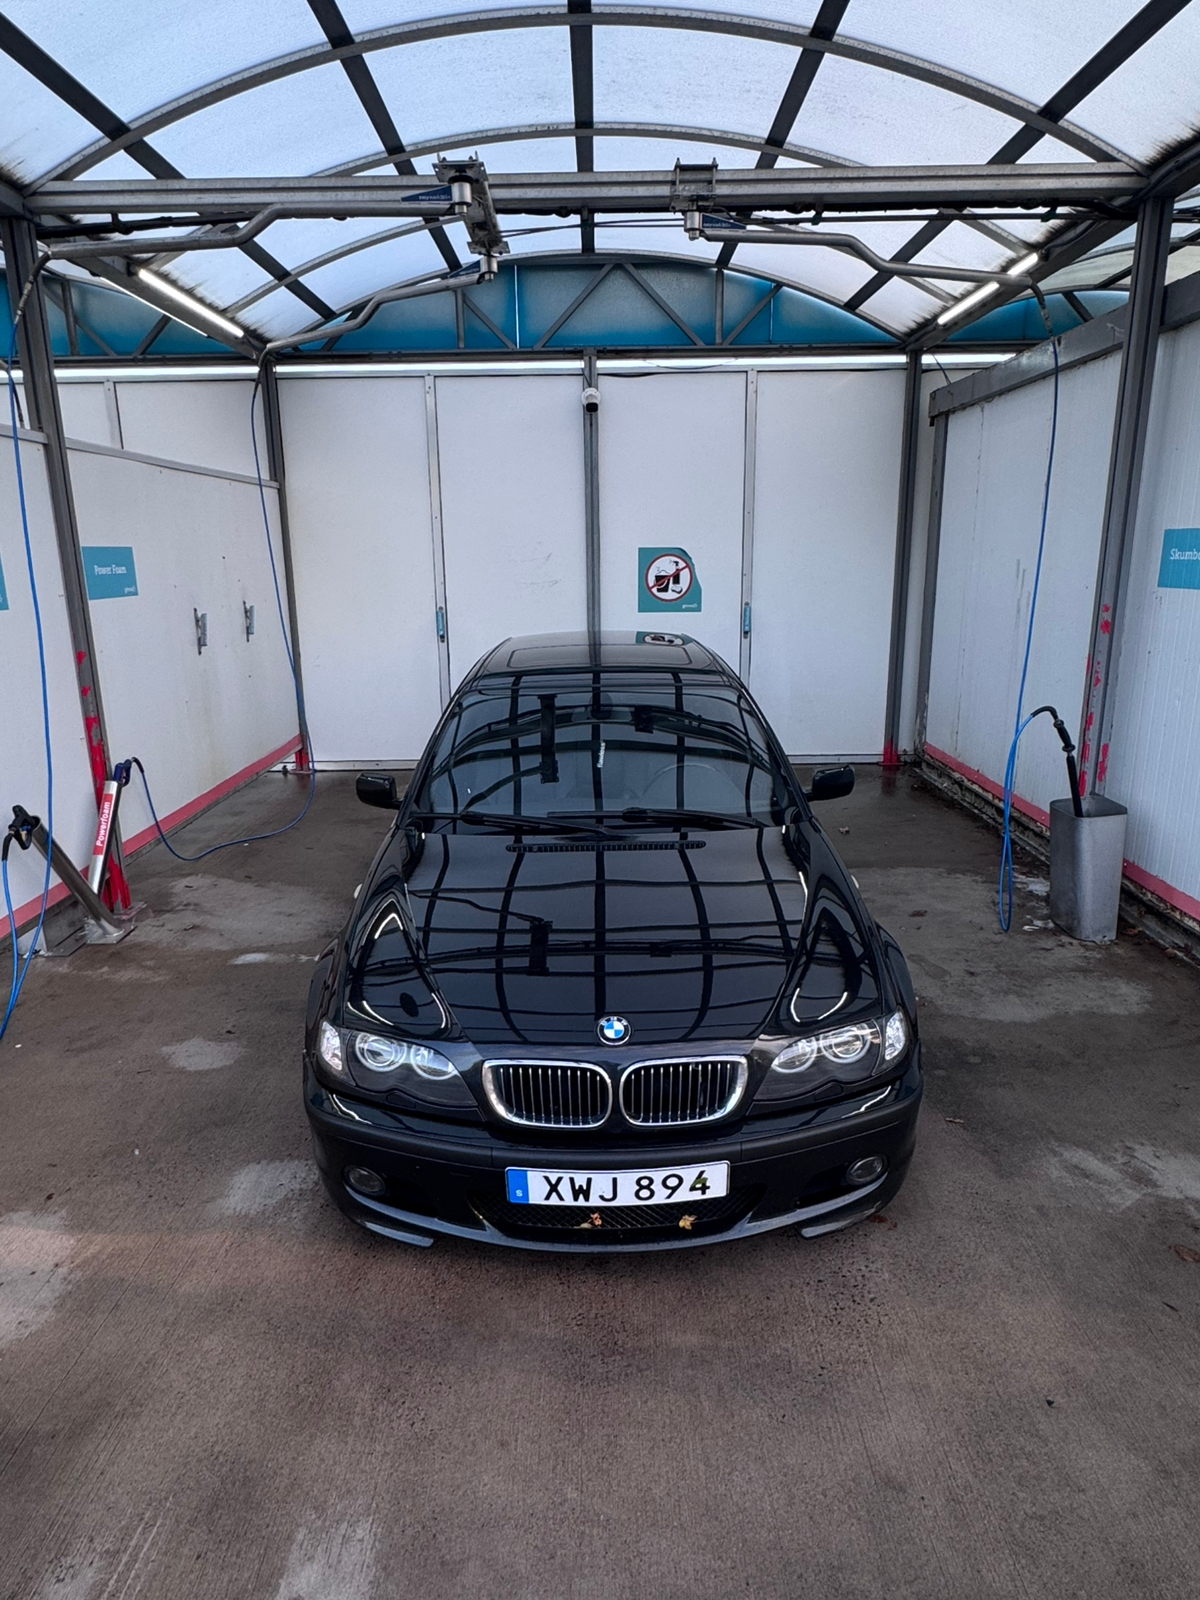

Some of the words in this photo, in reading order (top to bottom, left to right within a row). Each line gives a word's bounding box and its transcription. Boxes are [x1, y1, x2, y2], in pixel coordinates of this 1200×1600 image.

[95, 801, 111, 847] Powerfoam
[515, 1189, 523, 1197] S
[542, 1175, 618, 1202] XWJ
[634, 1169, 711, 1201] 894
